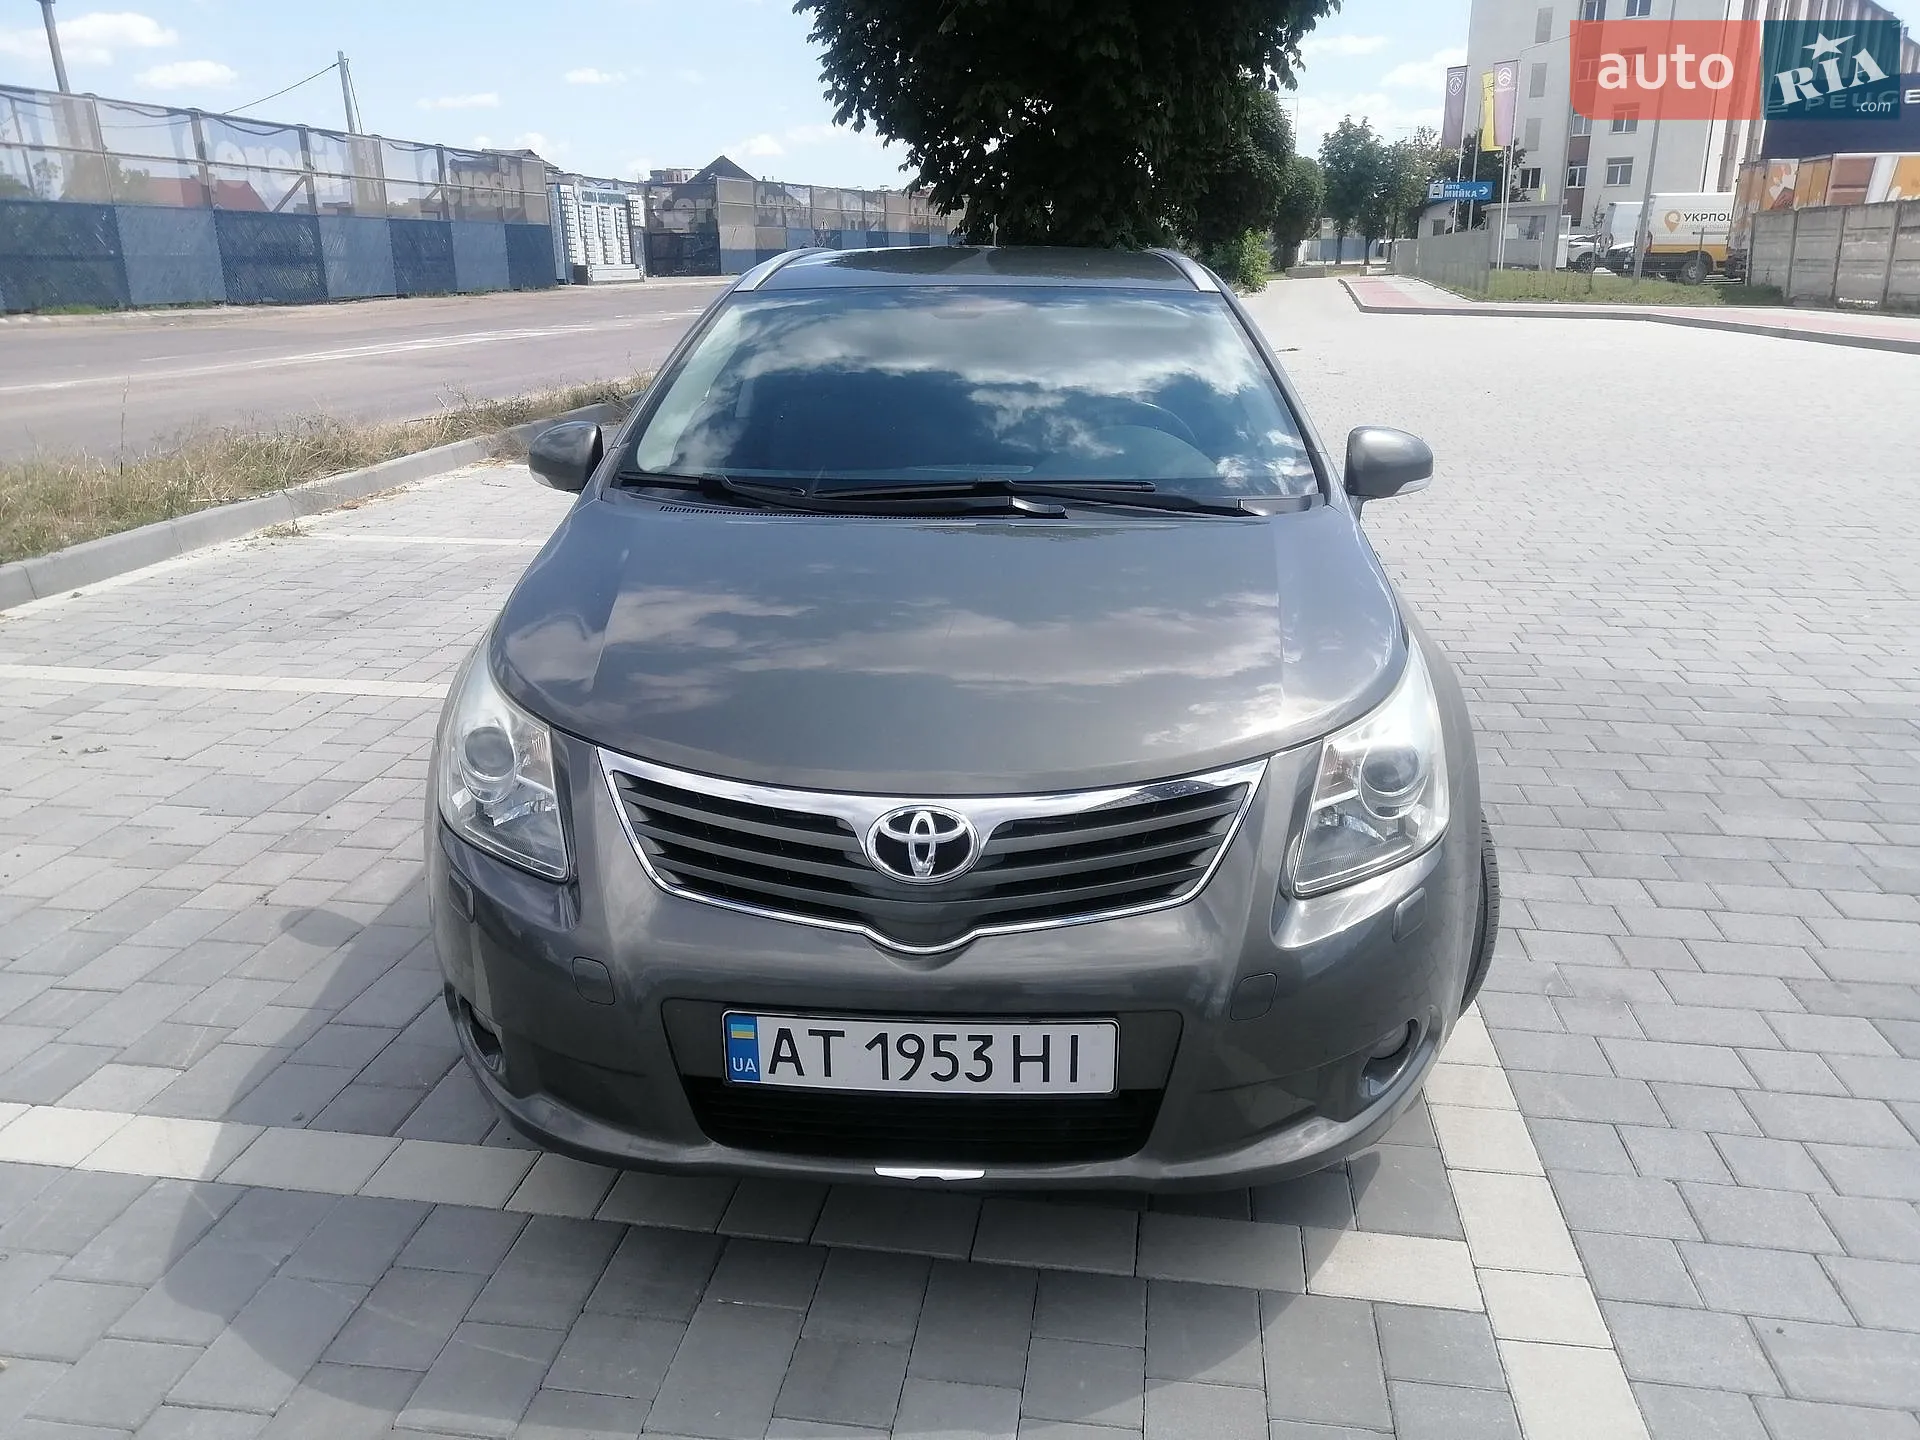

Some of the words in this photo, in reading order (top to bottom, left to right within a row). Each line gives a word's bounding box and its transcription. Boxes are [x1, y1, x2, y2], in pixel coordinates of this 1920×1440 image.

[423, 150, 521, 209] Ceresit
[1444, 189, 1477, 198] МИЙКА
[732, 1056, 757, 1073] UA
[767, 1027, 846, 1079] AT
[864, 1031, 994, 1084] 1953
[1012, 1033, 1080, 1084] HI
